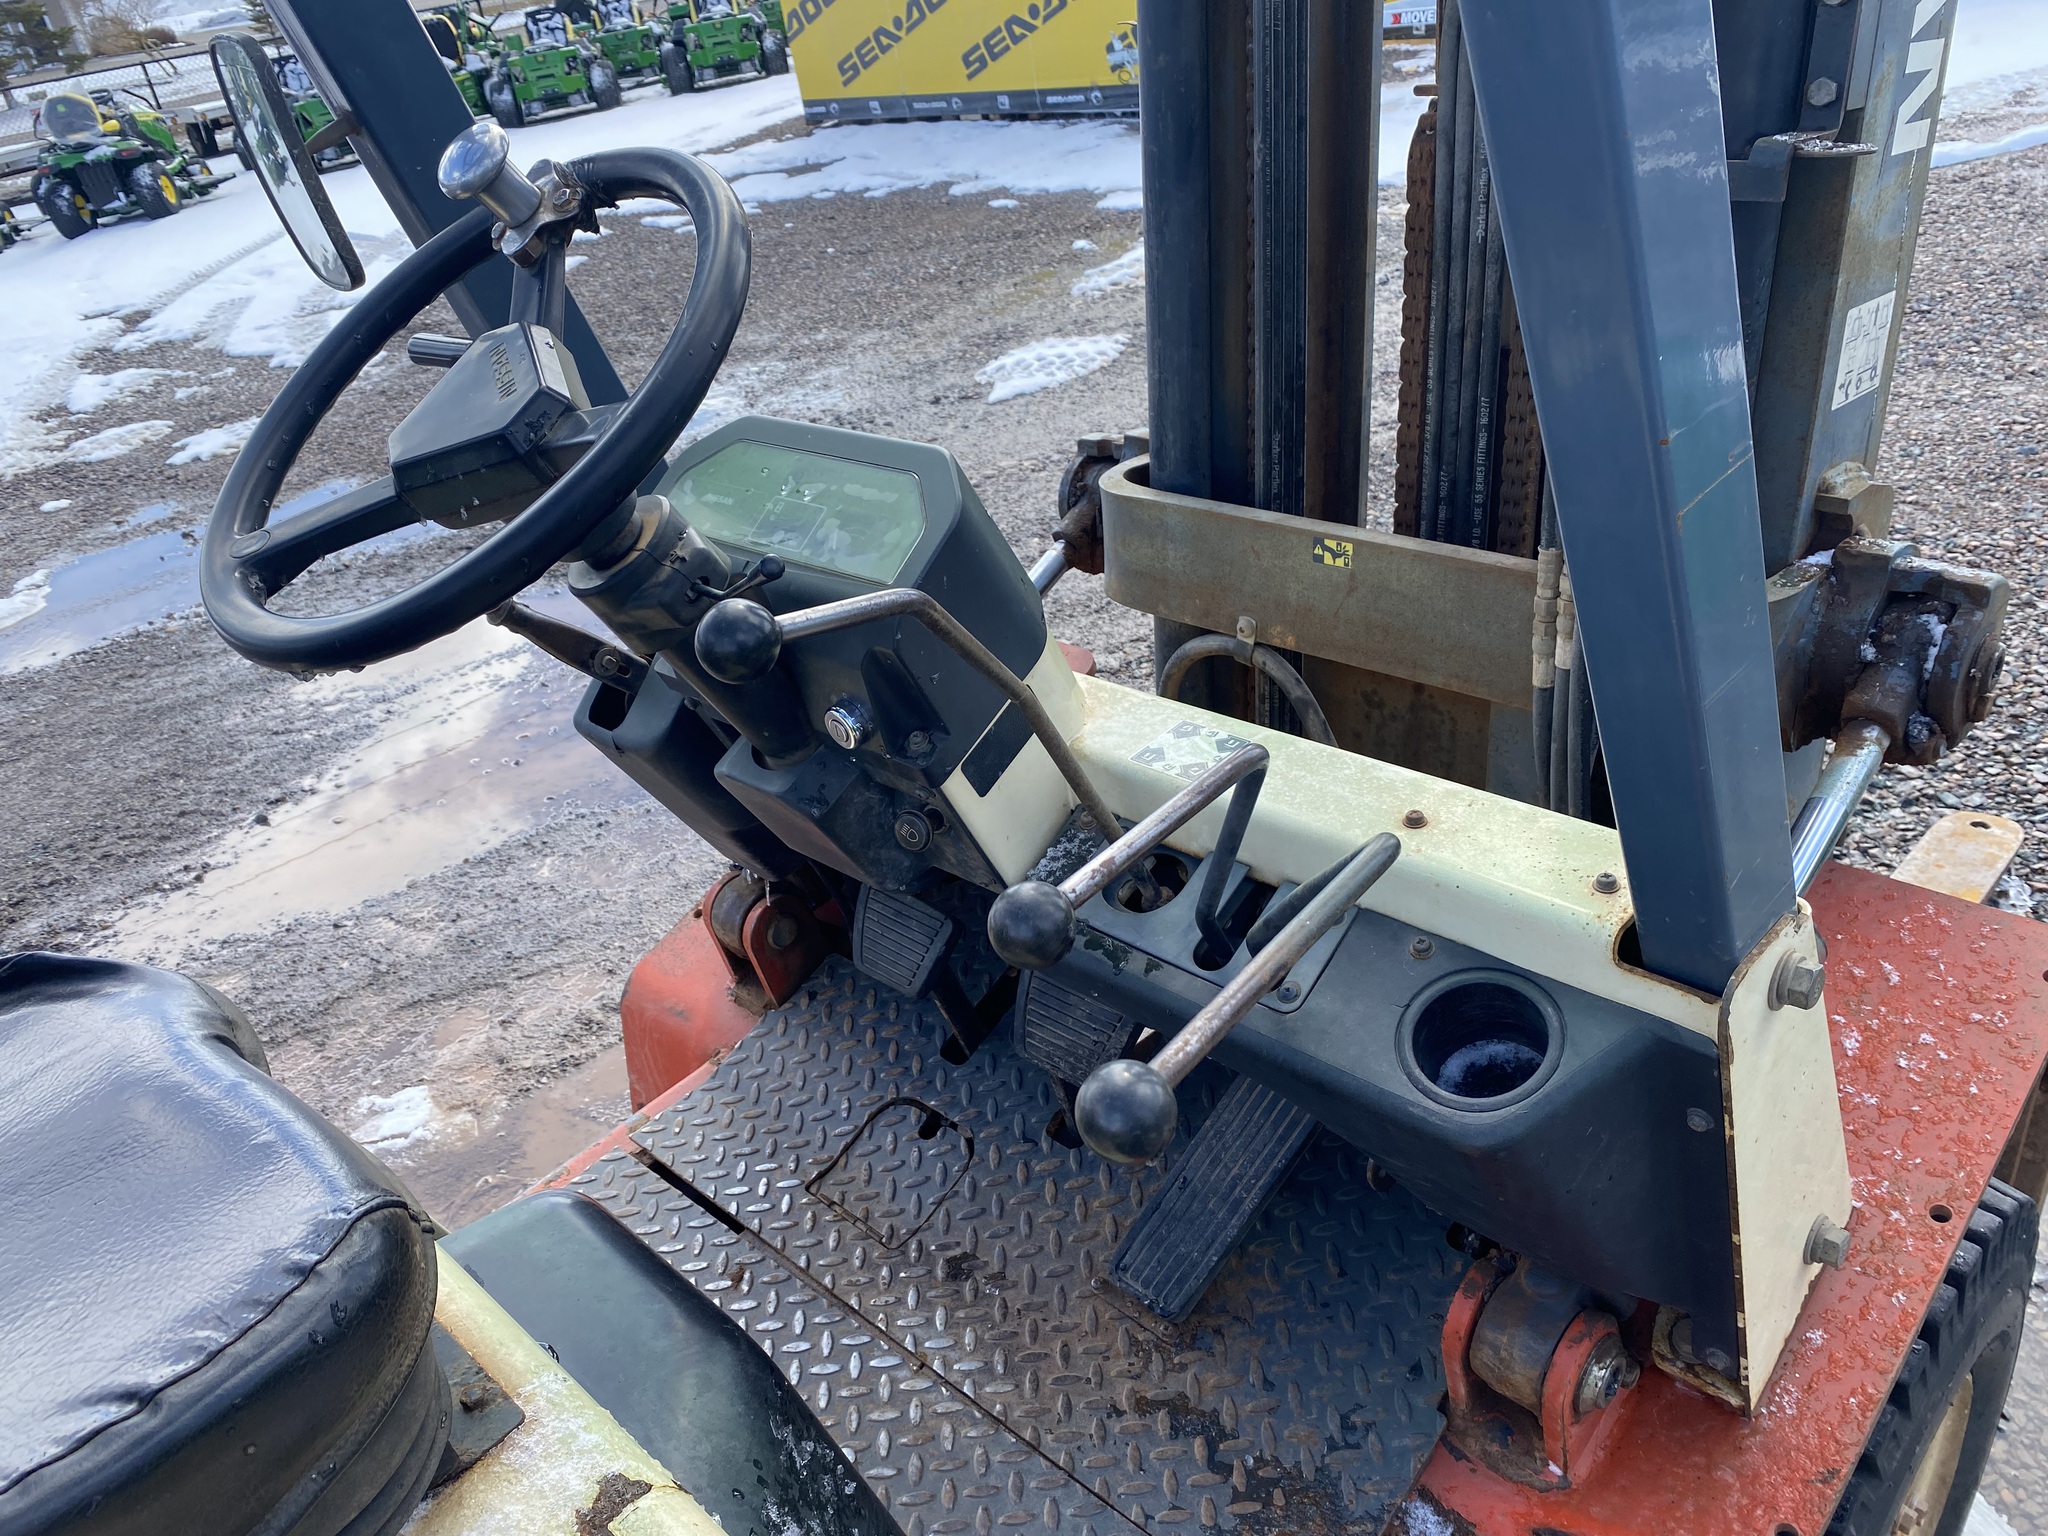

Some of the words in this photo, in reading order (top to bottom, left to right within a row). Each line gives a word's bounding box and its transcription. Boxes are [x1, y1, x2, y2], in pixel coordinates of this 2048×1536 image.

[1400, 9, 1435, 24] MOVE
[1477, 167, 1488, 202] Parflex
[1476, 203, 1487, 243] Parker
[488, 342, 517, 402] NISSAN
[1479, 397, 1490, 425] 160277
[1476, 428, 1488, 464] FITTINGS-
[1475, 466, 1485, 491] SERIES
[1475, 494, 1484, 504] 55
